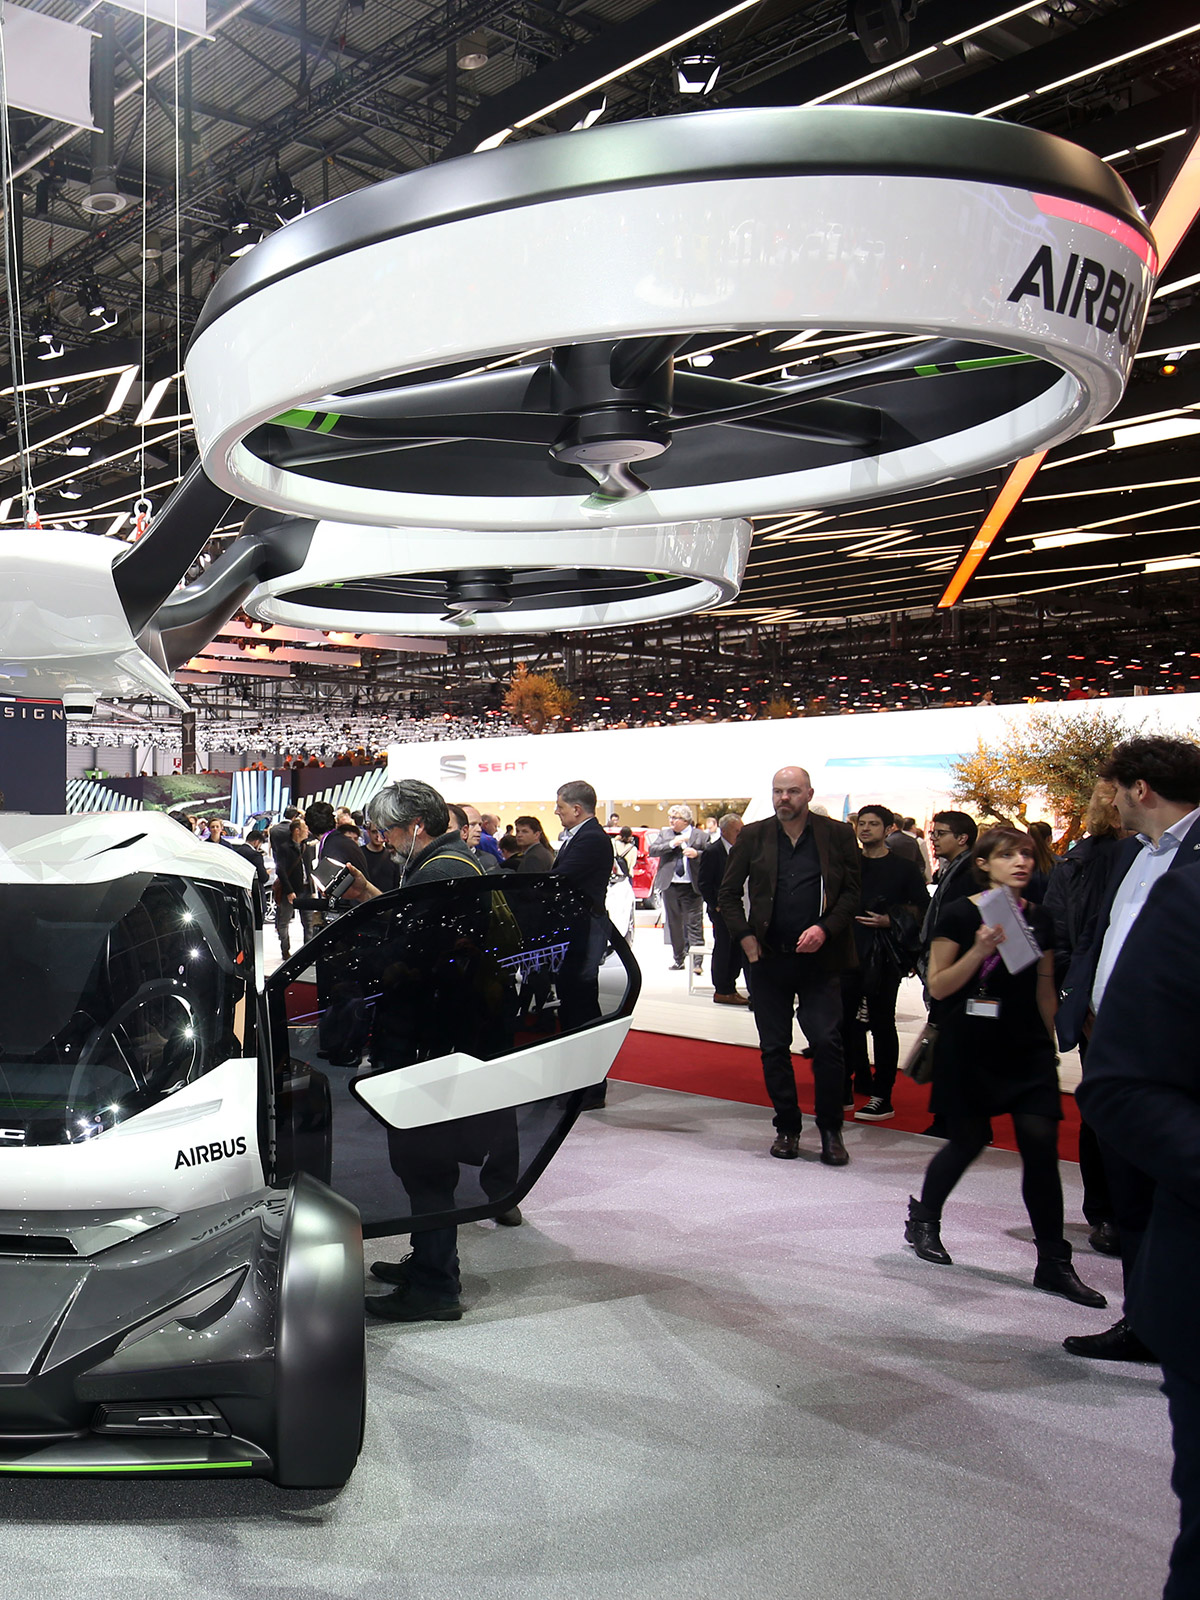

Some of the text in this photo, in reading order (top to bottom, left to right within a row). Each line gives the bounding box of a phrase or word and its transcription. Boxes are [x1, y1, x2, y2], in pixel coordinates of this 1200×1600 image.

[1007, 244, 1142, 345] AIRBU
[478, 761, 528, 773] SEAT
[174, 1136, 247, 1170] AIRBUS
